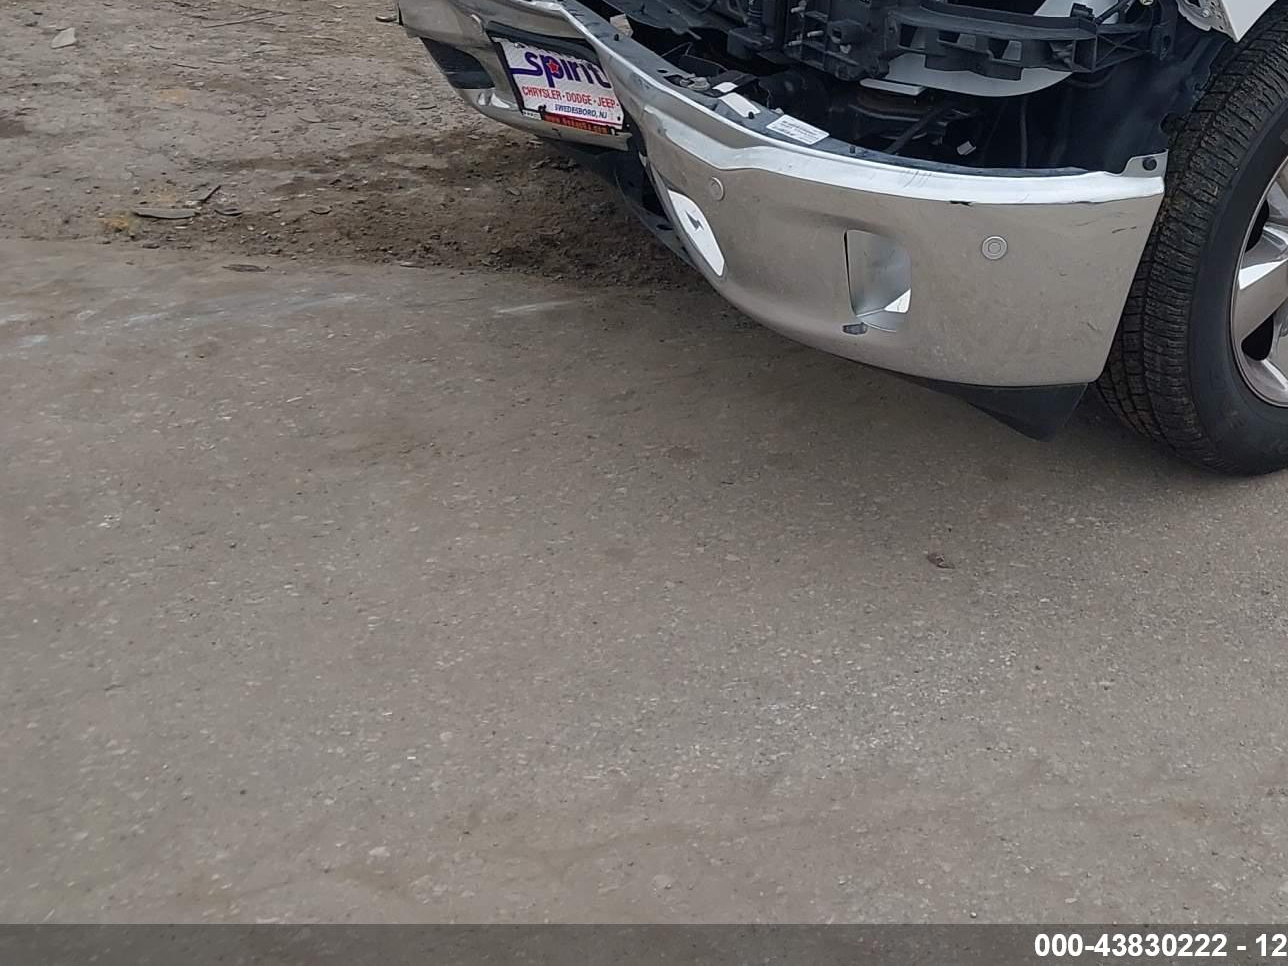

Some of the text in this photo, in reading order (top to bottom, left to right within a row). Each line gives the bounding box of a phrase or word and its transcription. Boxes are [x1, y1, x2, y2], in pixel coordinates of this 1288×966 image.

[521, 85, 616, 109] CHRYSLER DODGE JEEP
[599, 109, 608, 119] NJ
